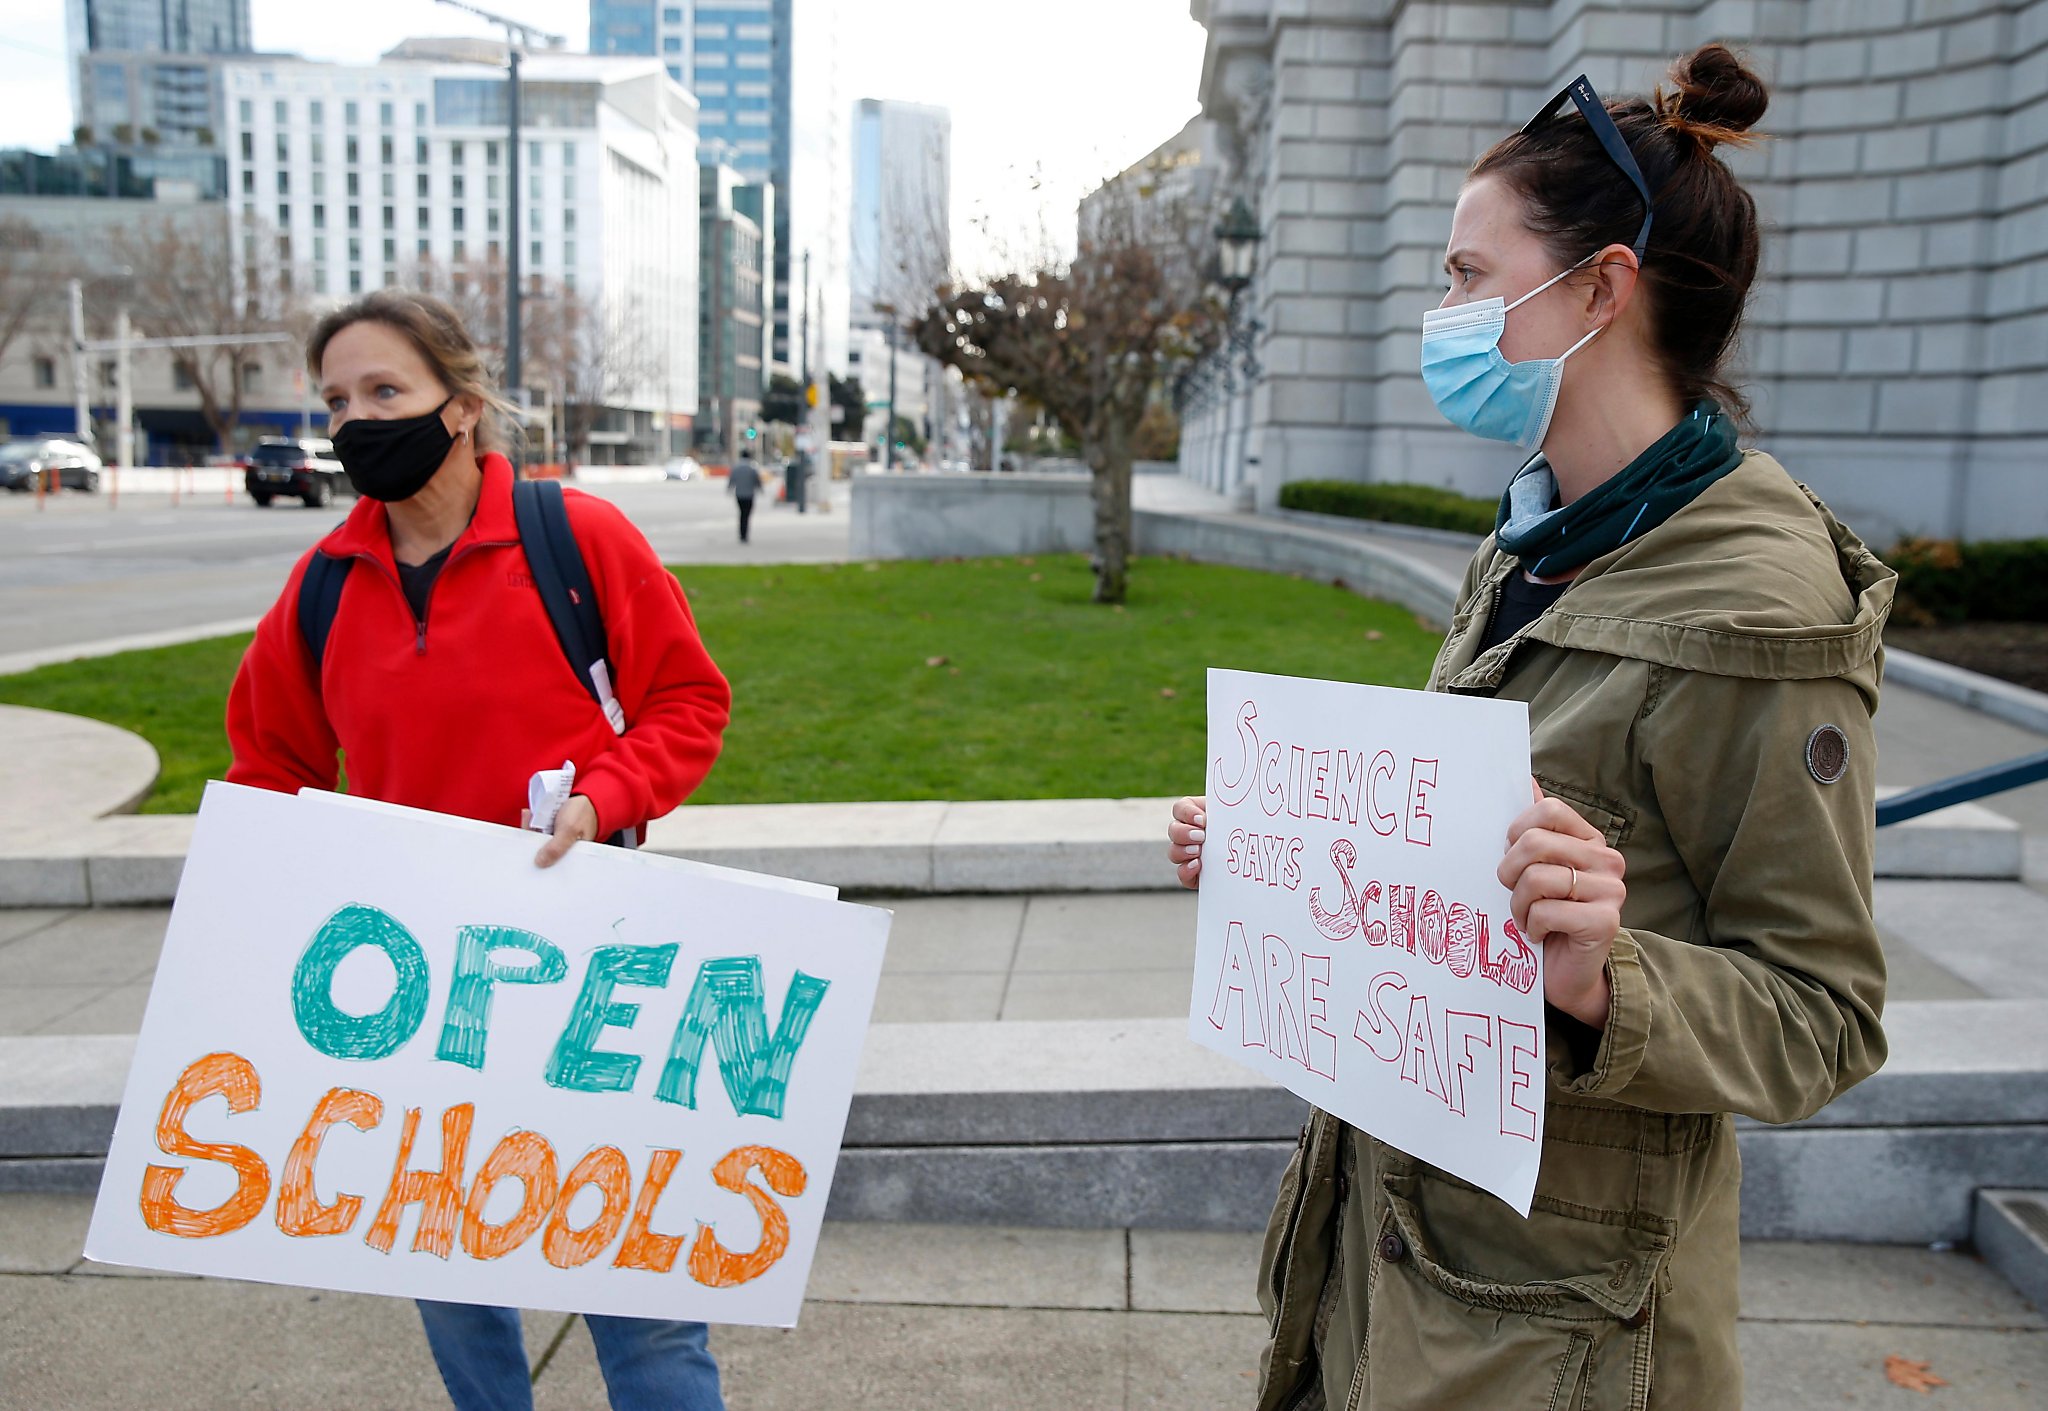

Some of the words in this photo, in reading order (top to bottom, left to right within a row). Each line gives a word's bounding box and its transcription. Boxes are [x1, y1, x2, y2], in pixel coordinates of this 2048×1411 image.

[1213, 700, 1439, 846] SCIENCE
[290, 902, 834, 1121] OPEN
[1227, 828, 1304, 891] SAYS
[1309, 838, 1538, 995] SCHOOLS
[1208, 921, 1337, 1082] ARE
[1353, 971, 1538, 1142] SAFE
[138, 1051, 808, 1289] SCHOOLS
